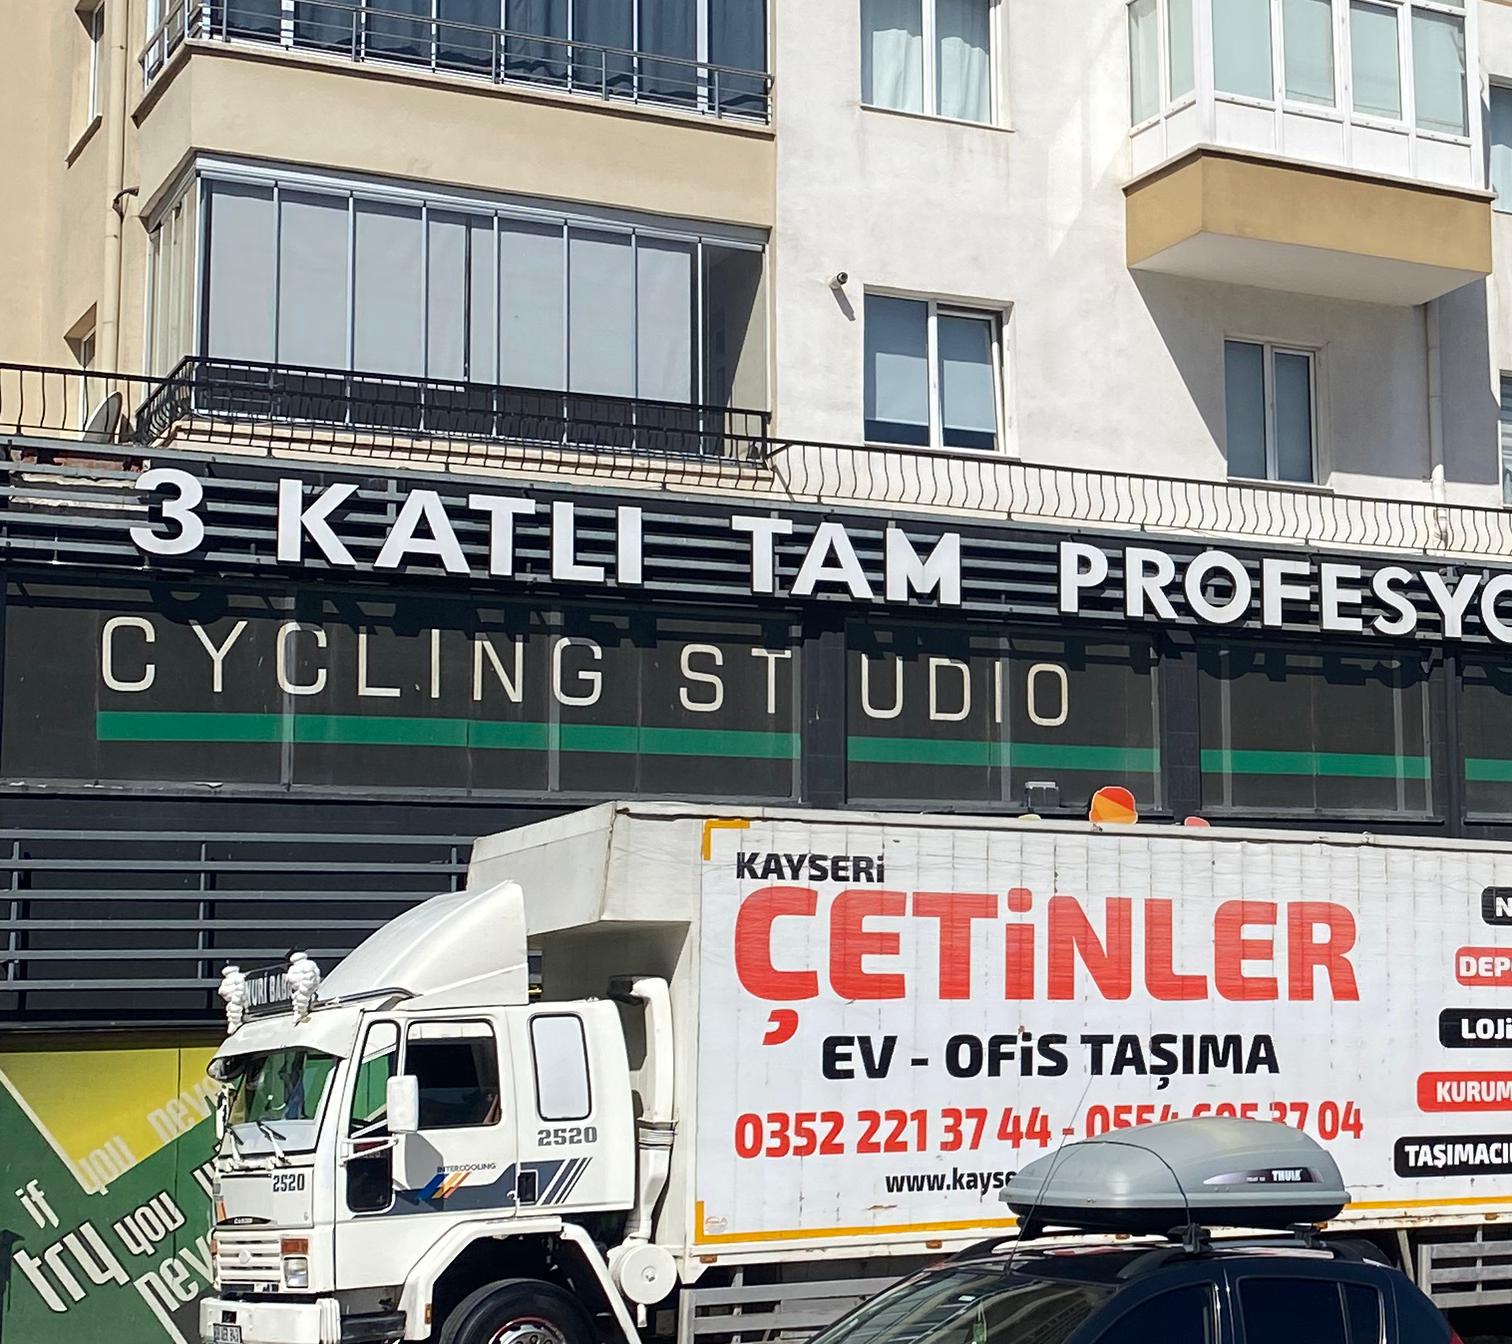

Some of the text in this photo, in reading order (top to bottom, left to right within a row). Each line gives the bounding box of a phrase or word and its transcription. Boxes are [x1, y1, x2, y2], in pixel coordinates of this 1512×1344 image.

[129, 467, 205, 556] 3
[277, 477, 643, 585] KATLI
[731, 514, 961, 606] TAM
[102, 614, 604, 708] CYCLING
[821, 1034, 898, 1081] EV
[1079, 1032, 1280, 1090] TAŞIMA
[536, 1126, 598, 1147] 2520
[734, 1112, 845, 1159] 0352
[856, 1109, 929, 1154] 221
[940, 1107, 989, 1150] 37
[1001, 1106, 1052, 1148] 44
[1317, 1100, 1364, 1141] 04
[272, 1173, 305, 1193] 2520
[436, 1162, 497, 1174] INTERCOOLING
[1271, 1168, 1303, 1182] THULE
[14, 1179, 60, 1229] if
[13, 1190, 187, 1313] try you
